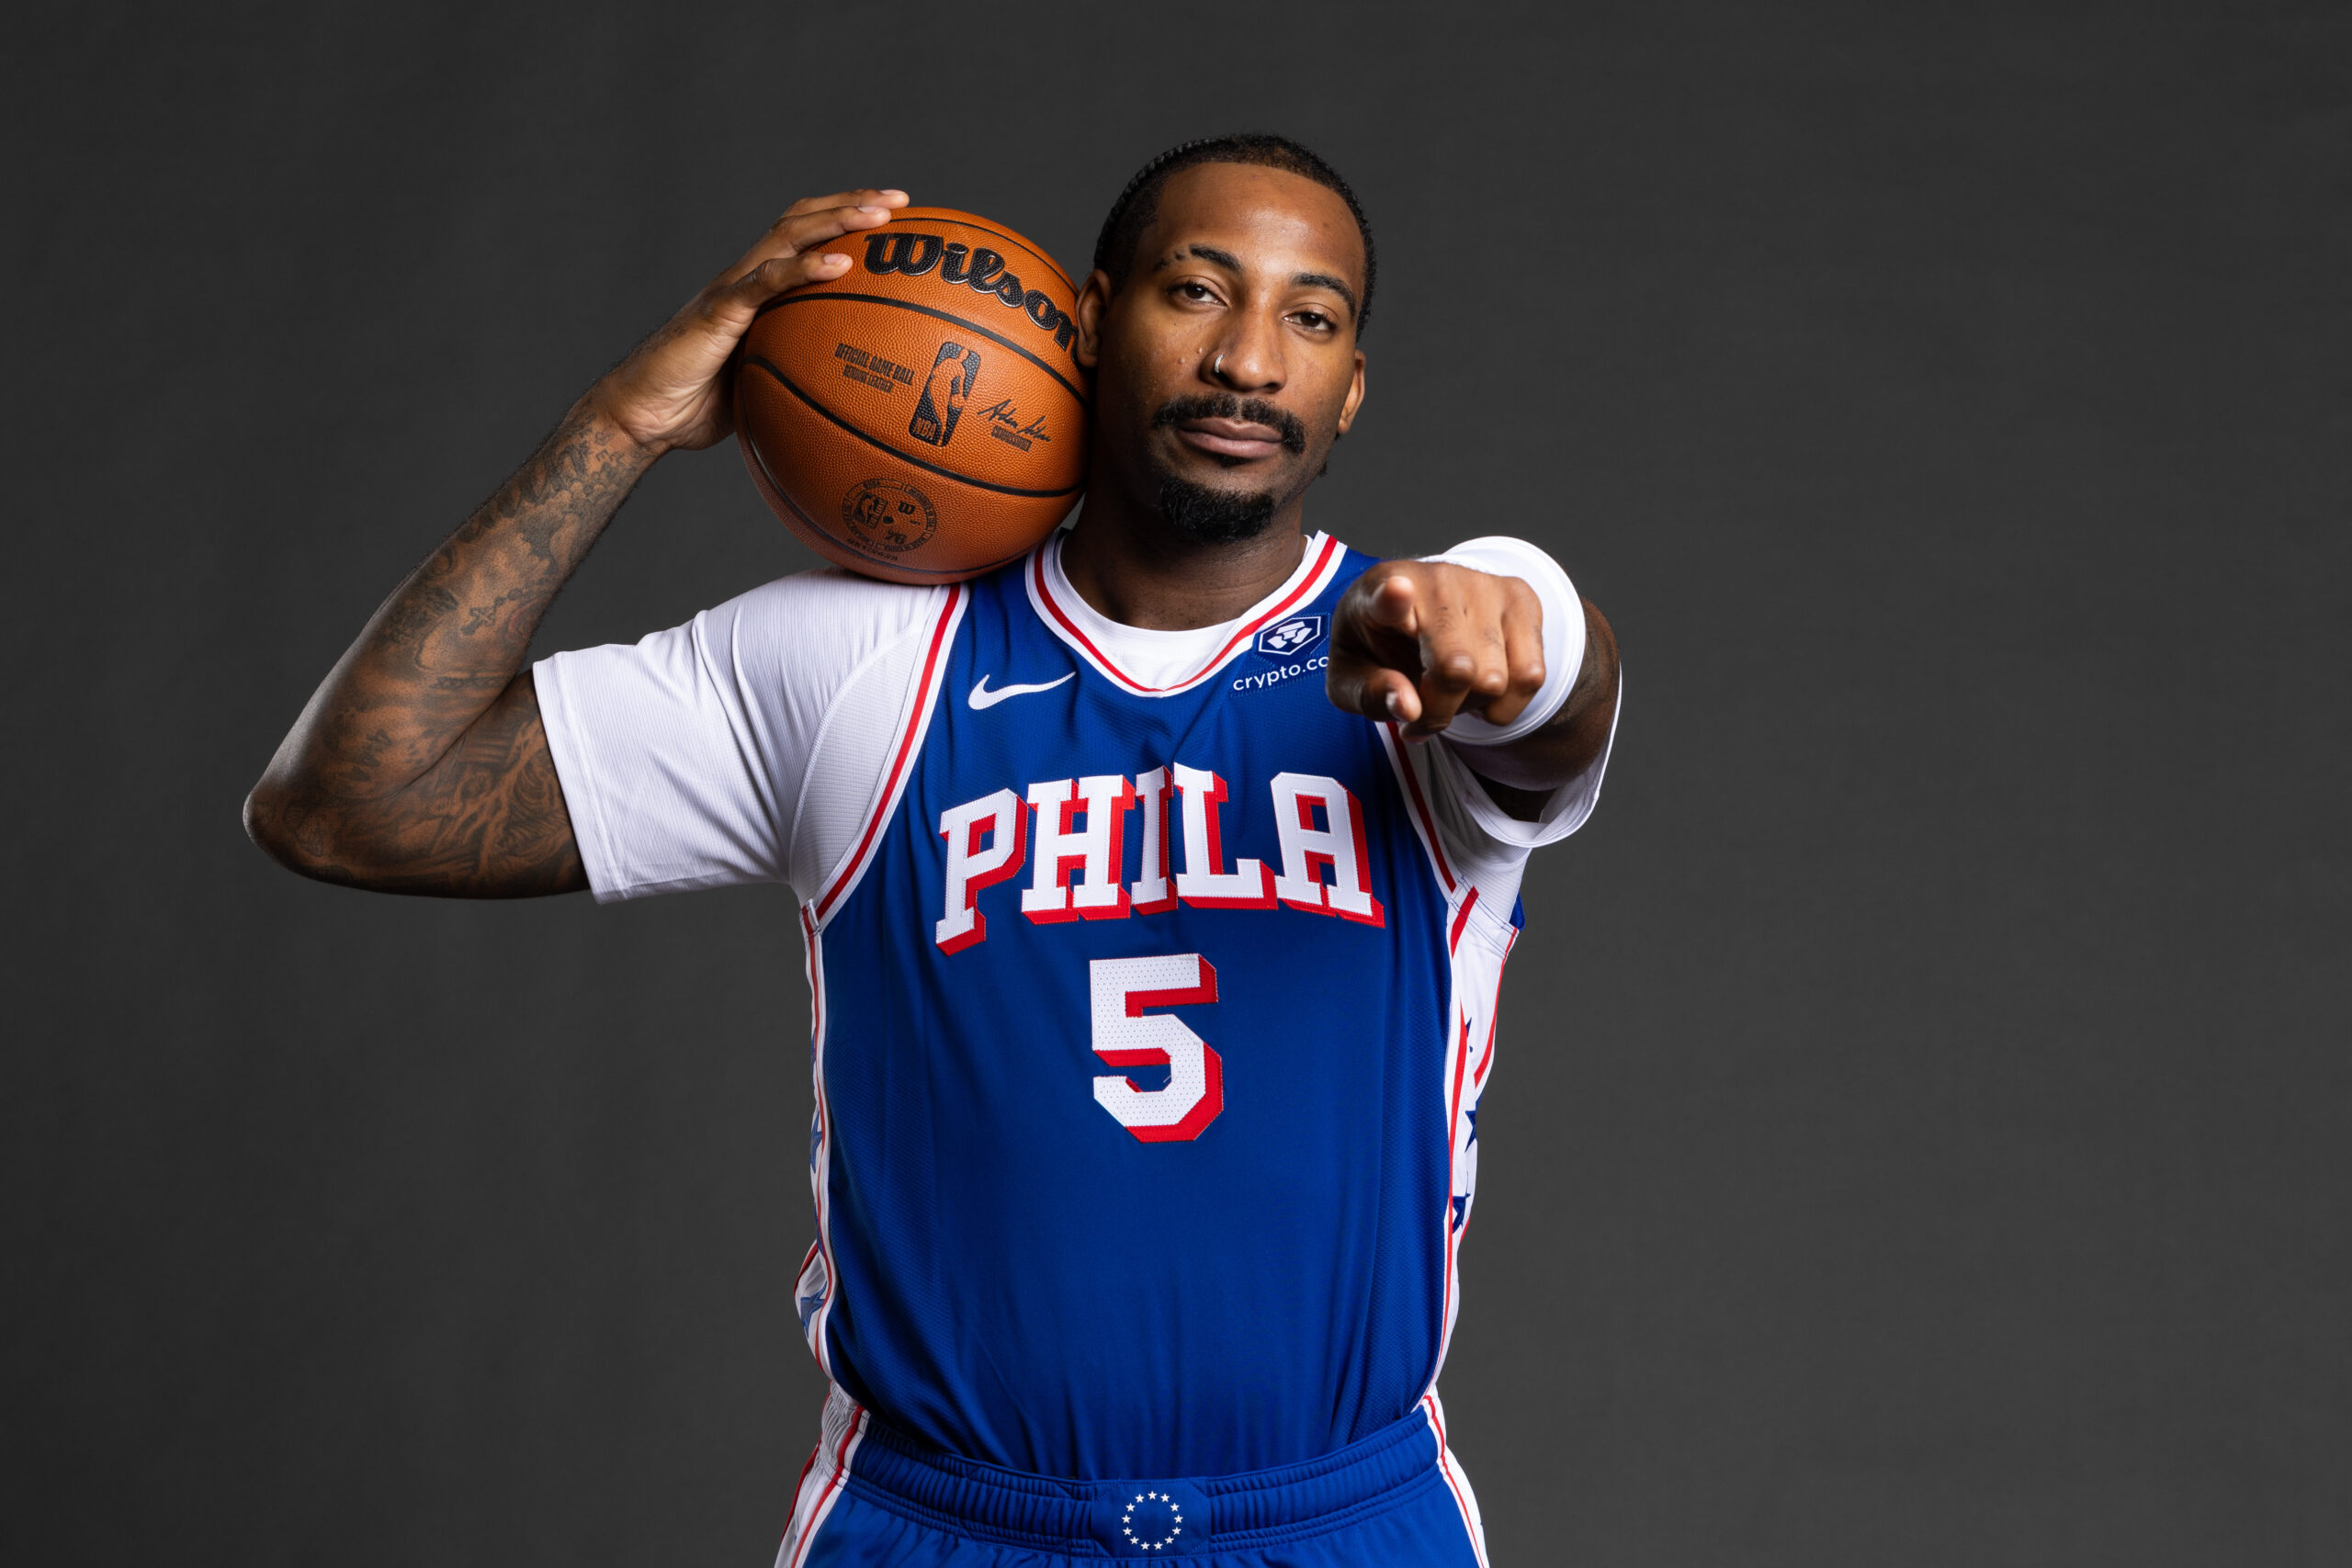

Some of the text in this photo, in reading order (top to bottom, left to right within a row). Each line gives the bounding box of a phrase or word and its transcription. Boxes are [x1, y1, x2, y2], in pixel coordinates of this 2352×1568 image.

[834, 343, 915, 386] OFFICIAL GAME BALL
[863, 232, 1079, 365] Wilson
[913, 416, 937, 441] NBA
[935, 761, 1386, 956] PHILA
[1089, 953, 1224, 1143] 5
